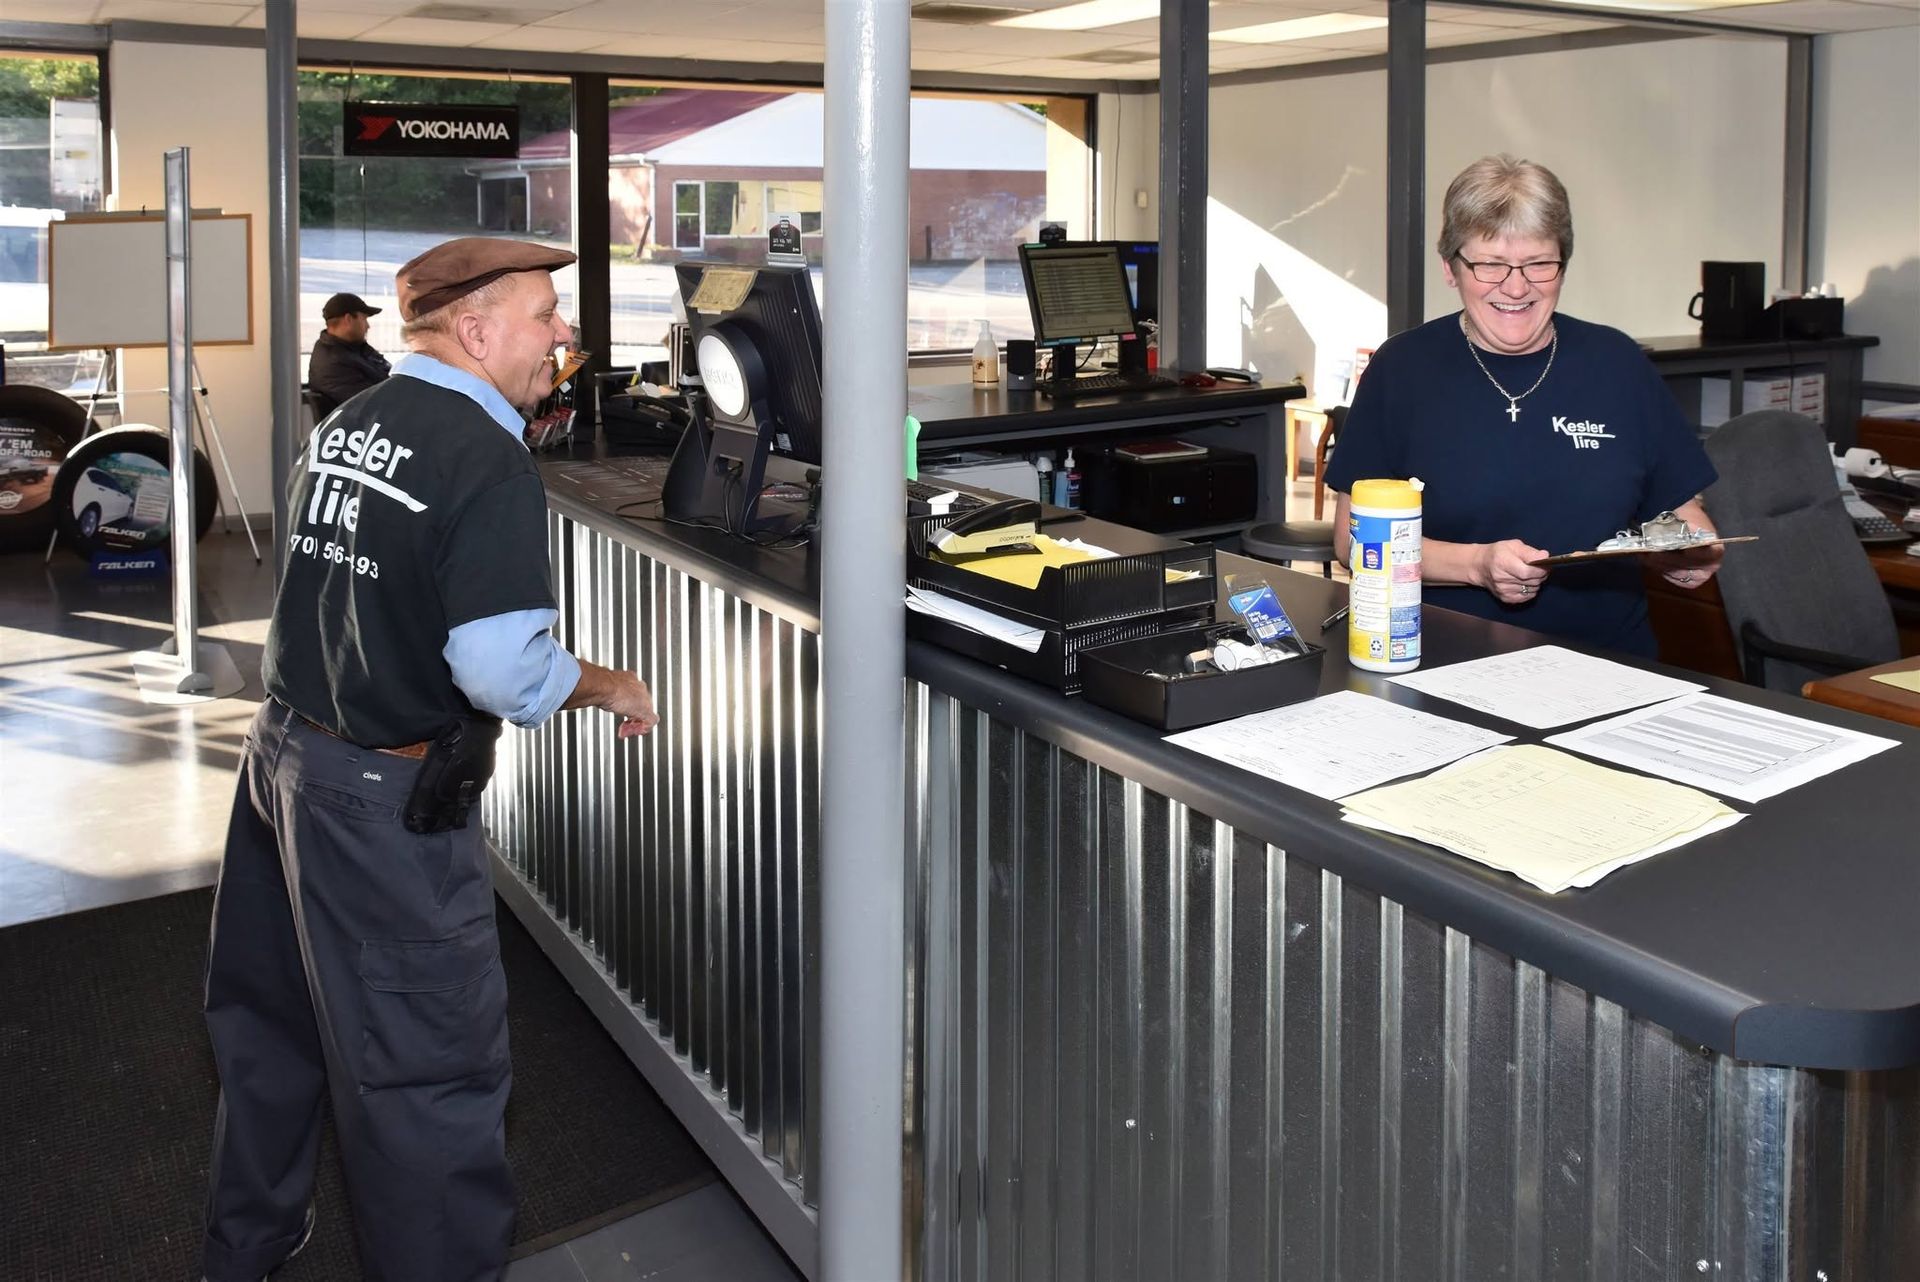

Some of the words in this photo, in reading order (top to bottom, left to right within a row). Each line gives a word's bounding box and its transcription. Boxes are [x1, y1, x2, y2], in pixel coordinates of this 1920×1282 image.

[396, 119, 510, 140] YOKOHAMA
[1552, 416, 1606, 434] Kesler
[1573, 434, 1600, 450] Tire
[98, 560, 156, 570] FALKEN
